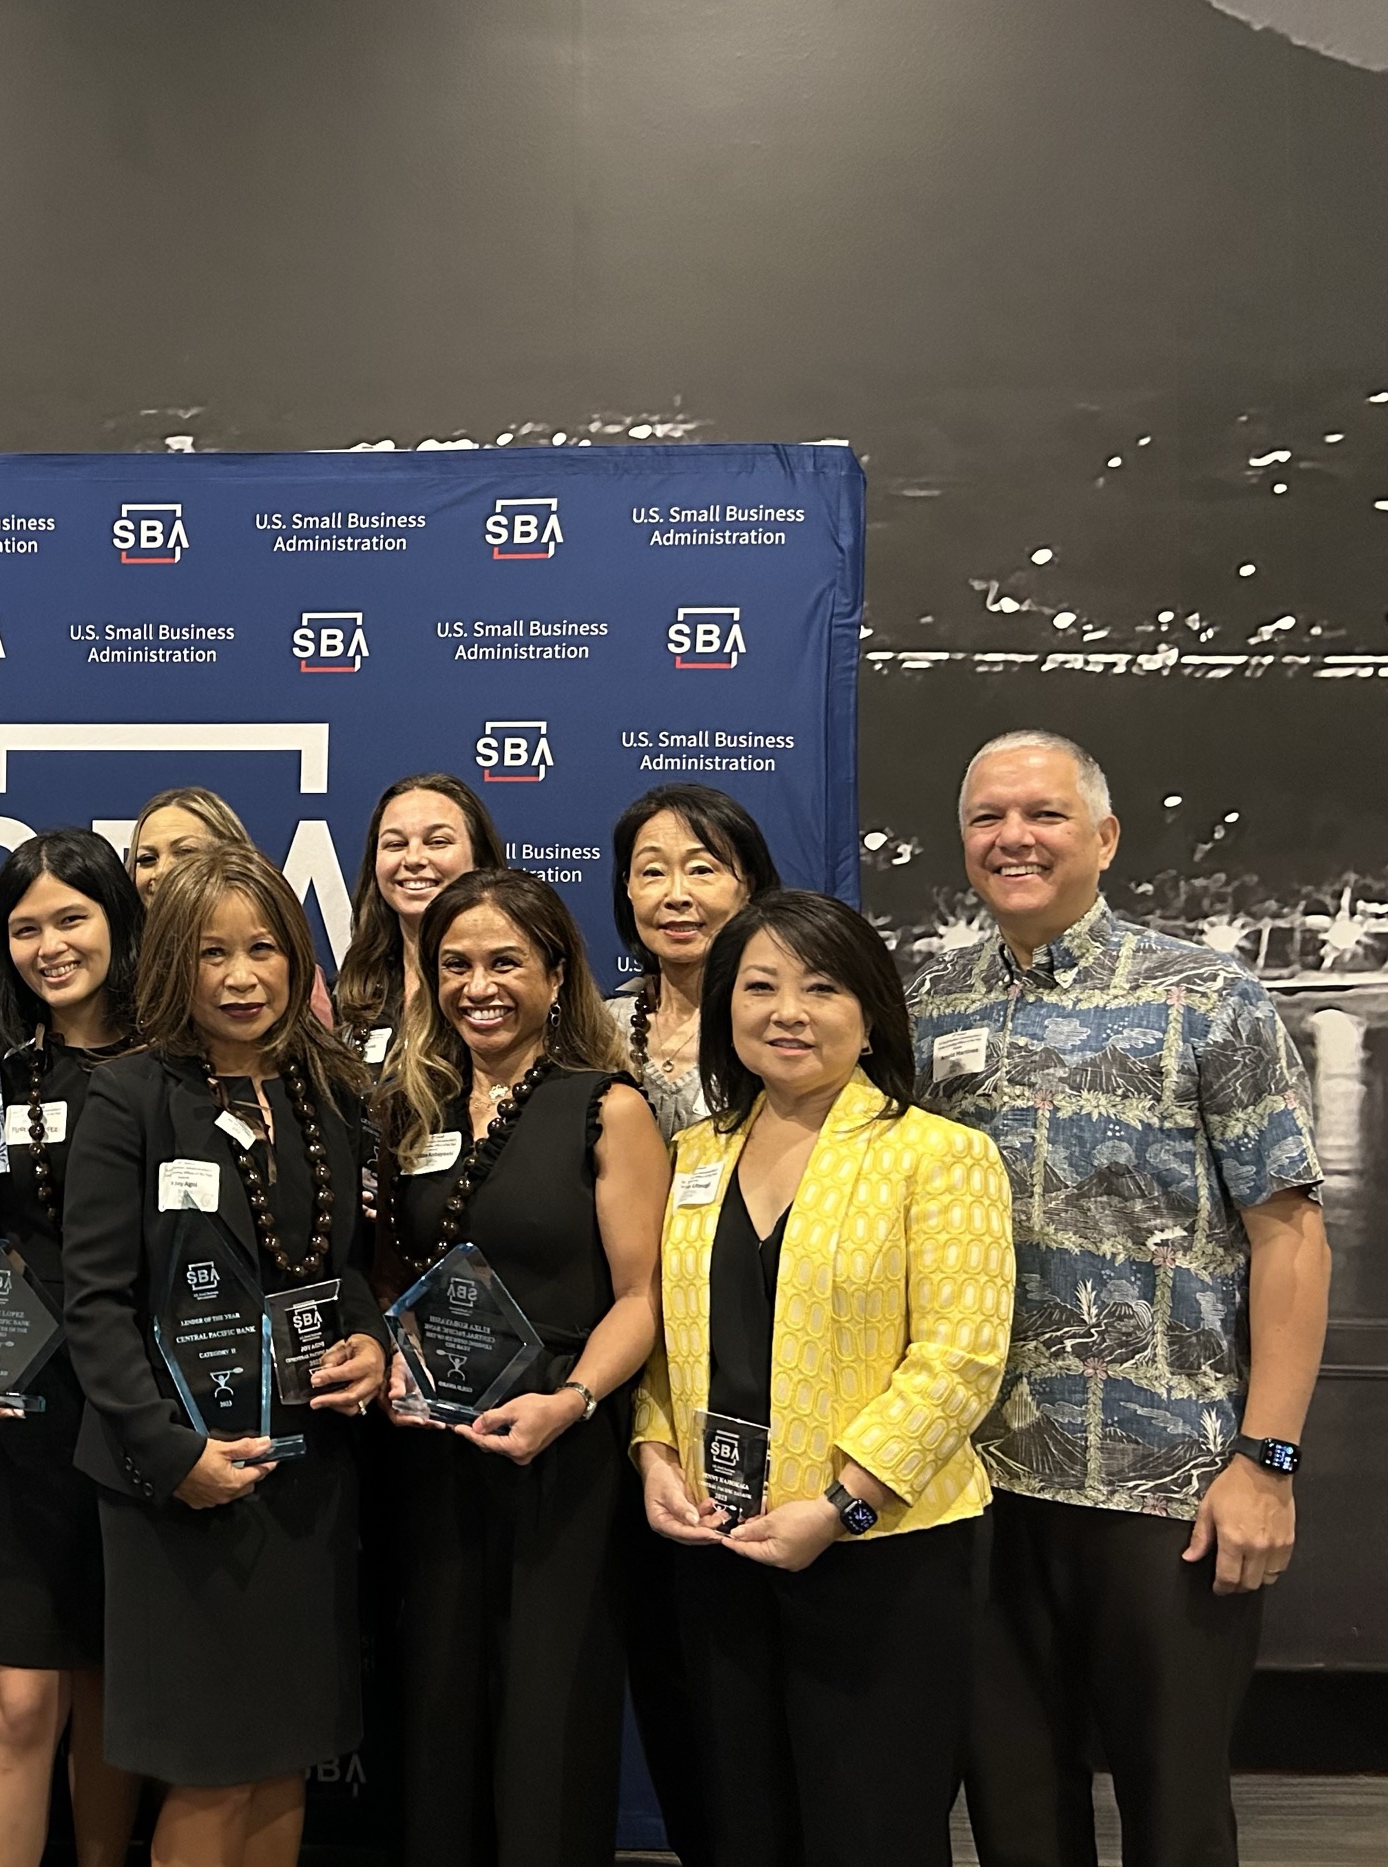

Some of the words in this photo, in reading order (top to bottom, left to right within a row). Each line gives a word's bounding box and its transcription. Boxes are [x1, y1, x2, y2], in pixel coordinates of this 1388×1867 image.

[255, 513, 287, 530] U.S.
[291, 511, 342, 530] Small
[347, 511, 426, 529] Business
[632, 506, 664, 524] U.S.
[668, 504, 721, 523] Small
[725, 504, 806, 522] Business
[112, 520, 189, 549] SBA
[485, 516, 563, 545] SBA
[649, 527, 786, 546] Administration
[273, 534, 407, 552] Administration
[70, 624, 100, 641] U.S.
[104, 623, 154, 641] Small
[158, 623, 235, 641] Business
[436, 621, 468, 638] U.S.
[473, 619, 524, 638] Small
[529, 619, 609, 637] Business
[292, 629, 369, 658] SBA
[667, 624, 746, 654] SBA
[87, 645, 217, 663] Administration
[454, 642, 589, 661] Administration
[621, 731, 654, 748] U.S.
[657, 730, 710, 748] Small
[714, 731, 795, 749] Business
[475, 738, 554, 768] SBA
[639, 753, 776, 772] Administration
[522, 843, 601, 860] Business
[186, 1268, 220, 1285] SBA
[181, 1316, 203, 1327] LENDER
[224, 1312, 240, 1321] YEAR
[293, 1311, 322, 1328] SBA
[176, 1331, 208, 1344] CENTRAL
[209, 1328, 236, 1339] PACIFIC
[236, 1325, 256, 1336] BANK
[199, 1349, 229, 1359] CATEGORY
[710, 1442, 739, 1461] SBA
